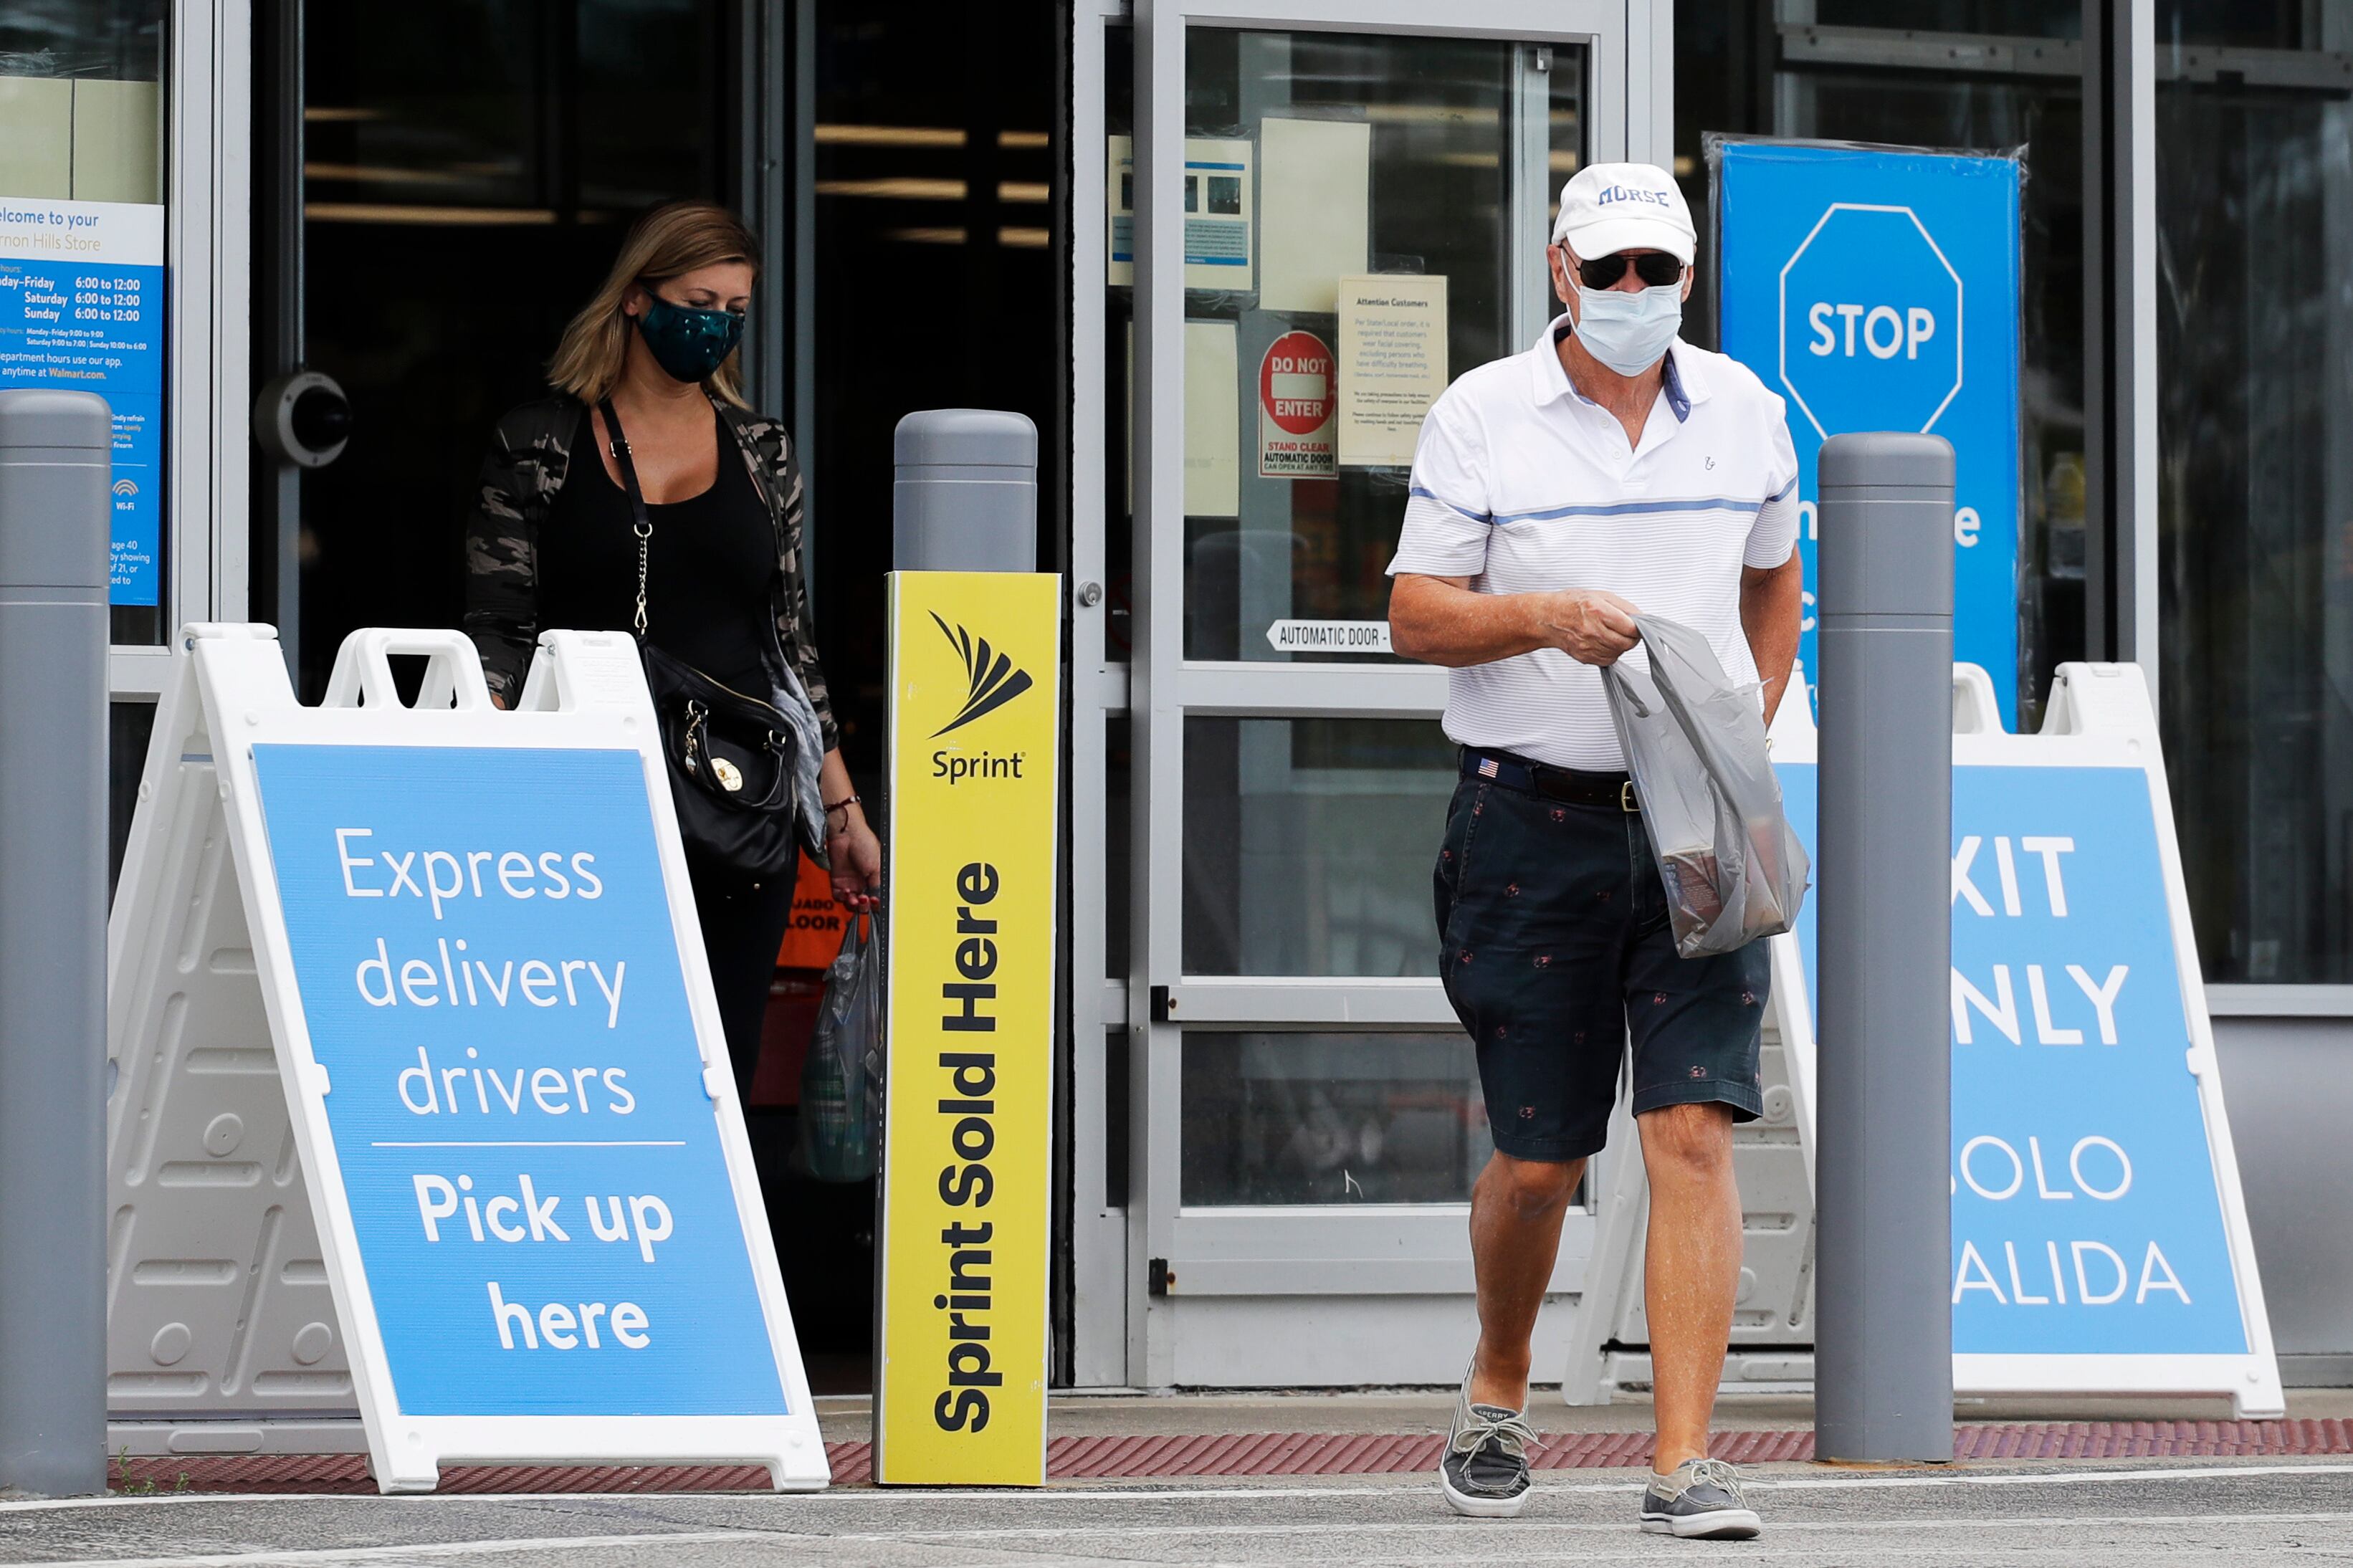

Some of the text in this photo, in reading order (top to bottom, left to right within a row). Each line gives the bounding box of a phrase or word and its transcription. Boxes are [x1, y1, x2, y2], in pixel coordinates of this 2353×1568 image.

[0, 207, 99, 230] lcome to your
[34, 232, 61, 249] Hills
[65, 234, 101, 252] Store
[75, 277, 99, 289] 6:00
[101, 279, 112, 290] to
[114, 279, 140, 291] 12:00
[24, 291, 140, 308] Saturday 6:00 to 12:00
[1357, 297, 1428, 307] Attention Customers
[24, 307, 140, 323] Sunday 6:00 to 12:00
[1809, 302, 1936, 360] STOP
[27, 338, 51, 347] Saturday
[89, 340, 110, 350] Sunday
[0, 352, 45, 363] epartment
[47, 353, 70, 364] hours
[105, 358, 123, 369] app.
[1271, 357, 1327, 373] DO NOT
[2, 365, 107, 380] anytime at Walmart.com.
[1275, 401, 1322, 417] ENTER
[1268, 441, 1330, 453] STAND CLEAR
[1264, 452, 1334, 464] AUTOMATIC DOOR
[116, 502, 135, 510] Wi-Fi
[112, 540, 138, 551] age 40
[120, 552, 151, 565] showing
[123, 576, 131, 585] to
[1279, 626, 1379, 646] AUTOMATIC DOOR
[932, 750, 1023, 785] Sprint
[335, 828, 603, 920] Express
[1951, 836, 2075, 917] XIT
[793, 899, 834, 909] JADO
[787, 915, 839, 930] OOR
[355, 937, 626, 1029] delivery
[1951, 964, 2129, 1046] NLY
[398, 1046, 636, 1115] drivers
[933, 862, 1003, 1433] Sprint Sold Here
[1951, 1135, 2132, 1200] OLO
[412, 1174, 674, 1263] Pick up
[1952, 1240, 2191, 1304] ALIDA
[487, 1281, 651, 1350] here
